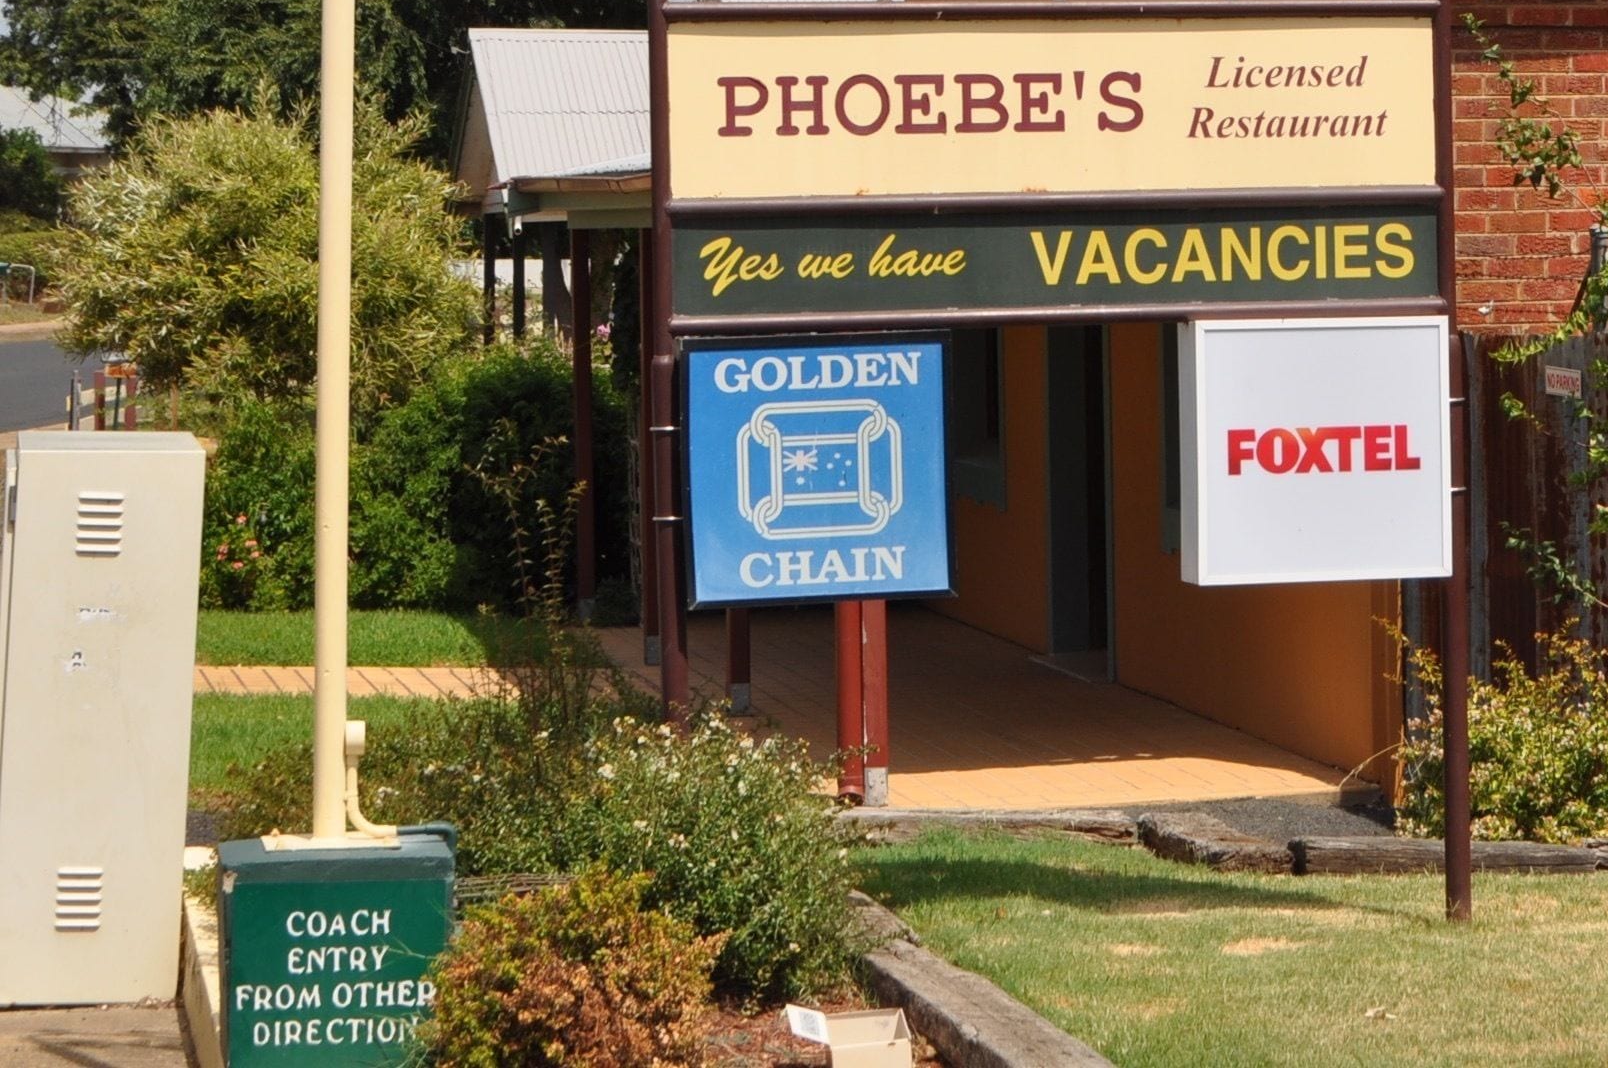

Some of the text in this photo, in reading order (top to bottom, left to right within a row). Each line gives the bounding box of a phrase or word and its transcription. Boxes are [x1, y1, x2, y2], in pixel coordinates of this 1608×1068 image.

[1204, 53, 1370, 90] Licensed
[716, 70, 1145, 138] PHOEBE'S
[1186, 105, 1389, 140] Restaurant
[698, 221, 1416, 297] Yes we have VACANCIES
[713, 350, 923, 394] GOLDEN
[1226, 423, 1422, 476] FOXTEL
[738, 544, 907, 586] CHAIN
[286, 908, 392, 938] COACH
[287, 944, 390, 974] ENTRY
[235, 979, 438, 1012] FROM OTHER
